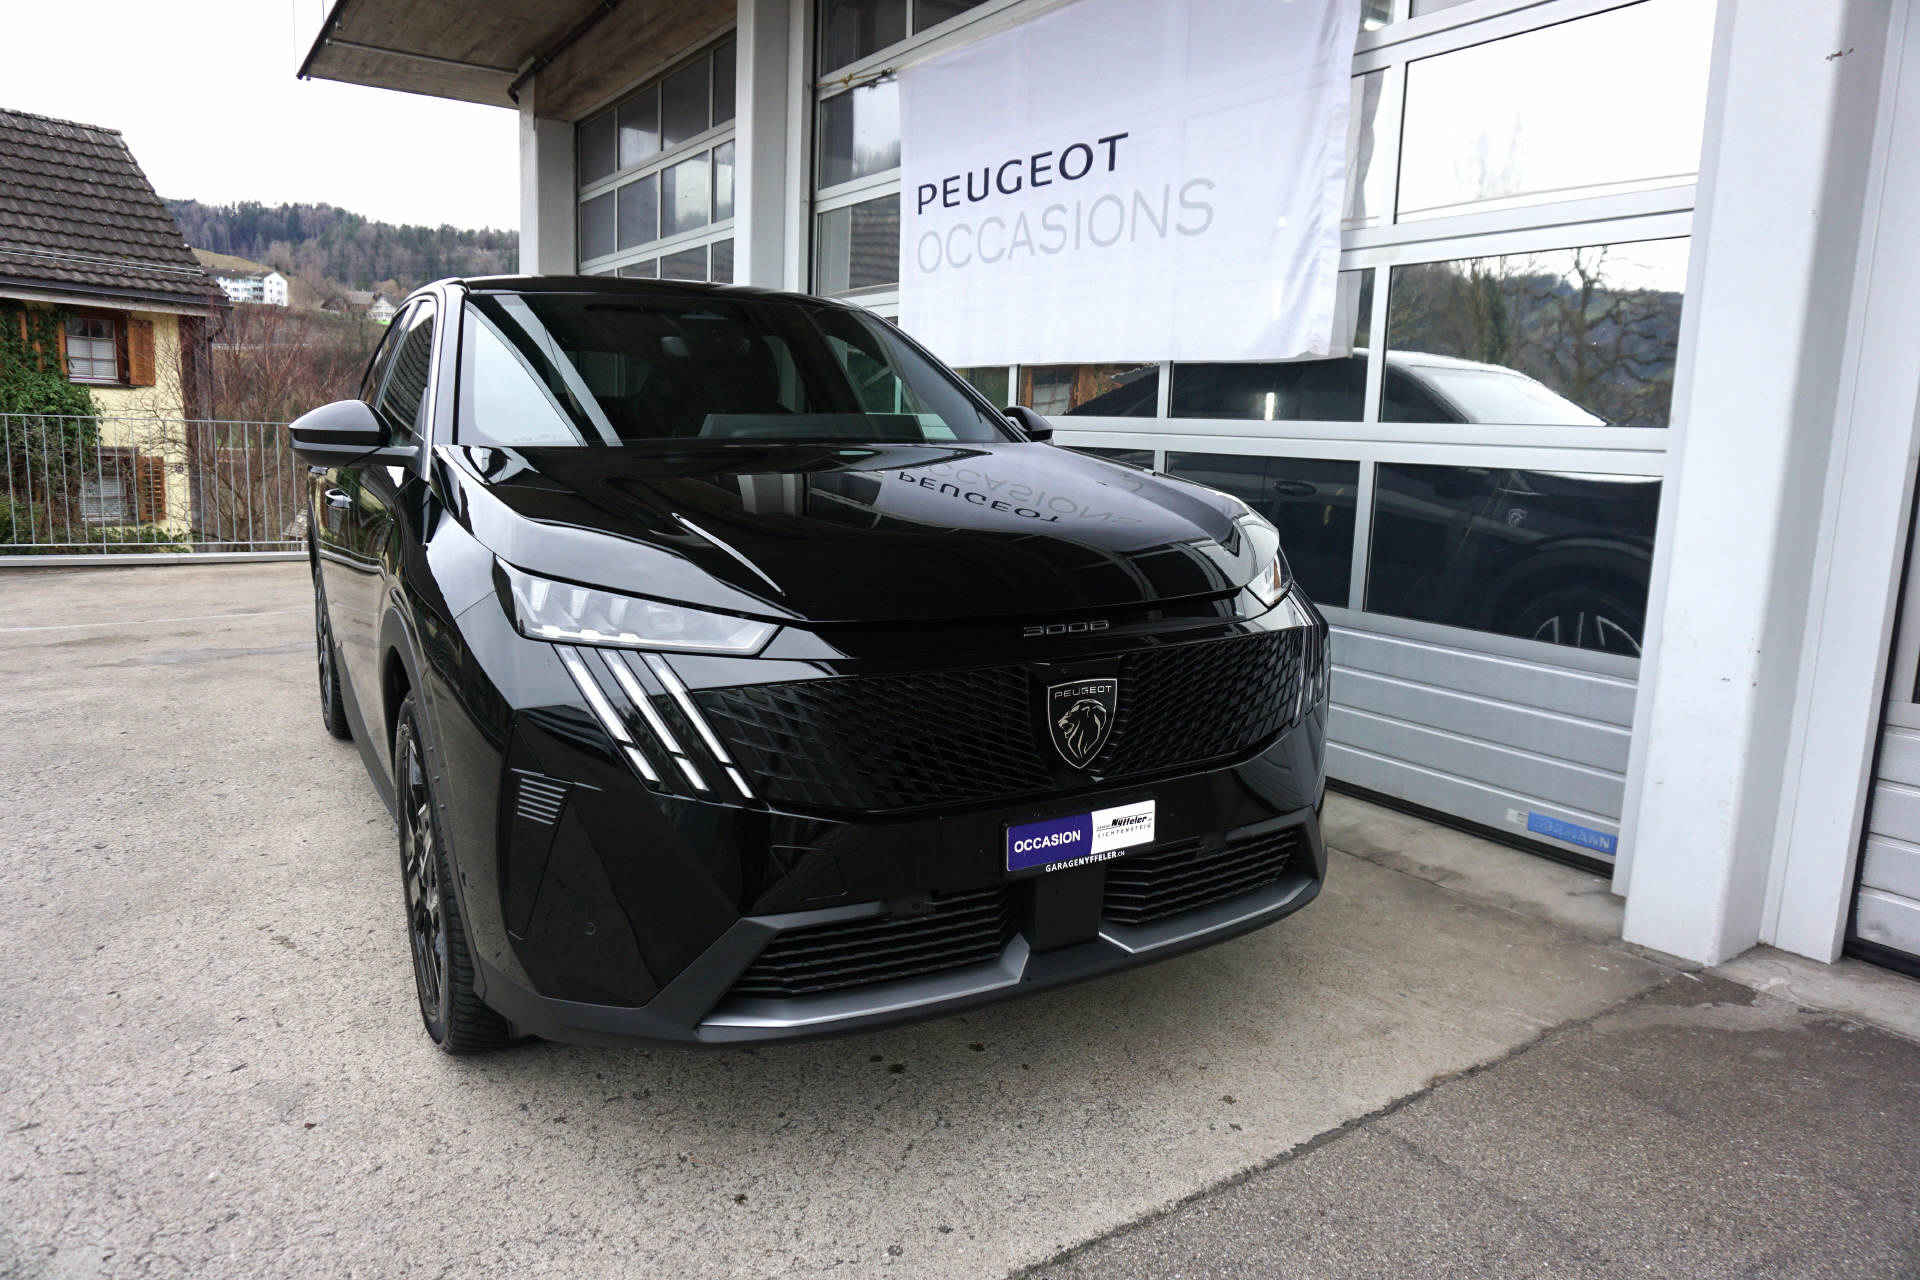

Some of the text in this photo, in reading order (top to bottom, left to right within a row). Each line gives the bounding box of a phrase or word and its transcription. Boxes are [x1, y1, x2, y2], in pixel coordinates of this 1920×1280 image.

[917, 132, 1129, 215] PEUGEOT
[917, 177, 1217, 274] OCCASIONS
[1023, 620, 1109, 637] 3008
[1054, 685, 1113, 700] PEUGEOT
[1111, 815, 1148, 827] Nyffeler
[1014, 829, 1081, 853] OCCASION
